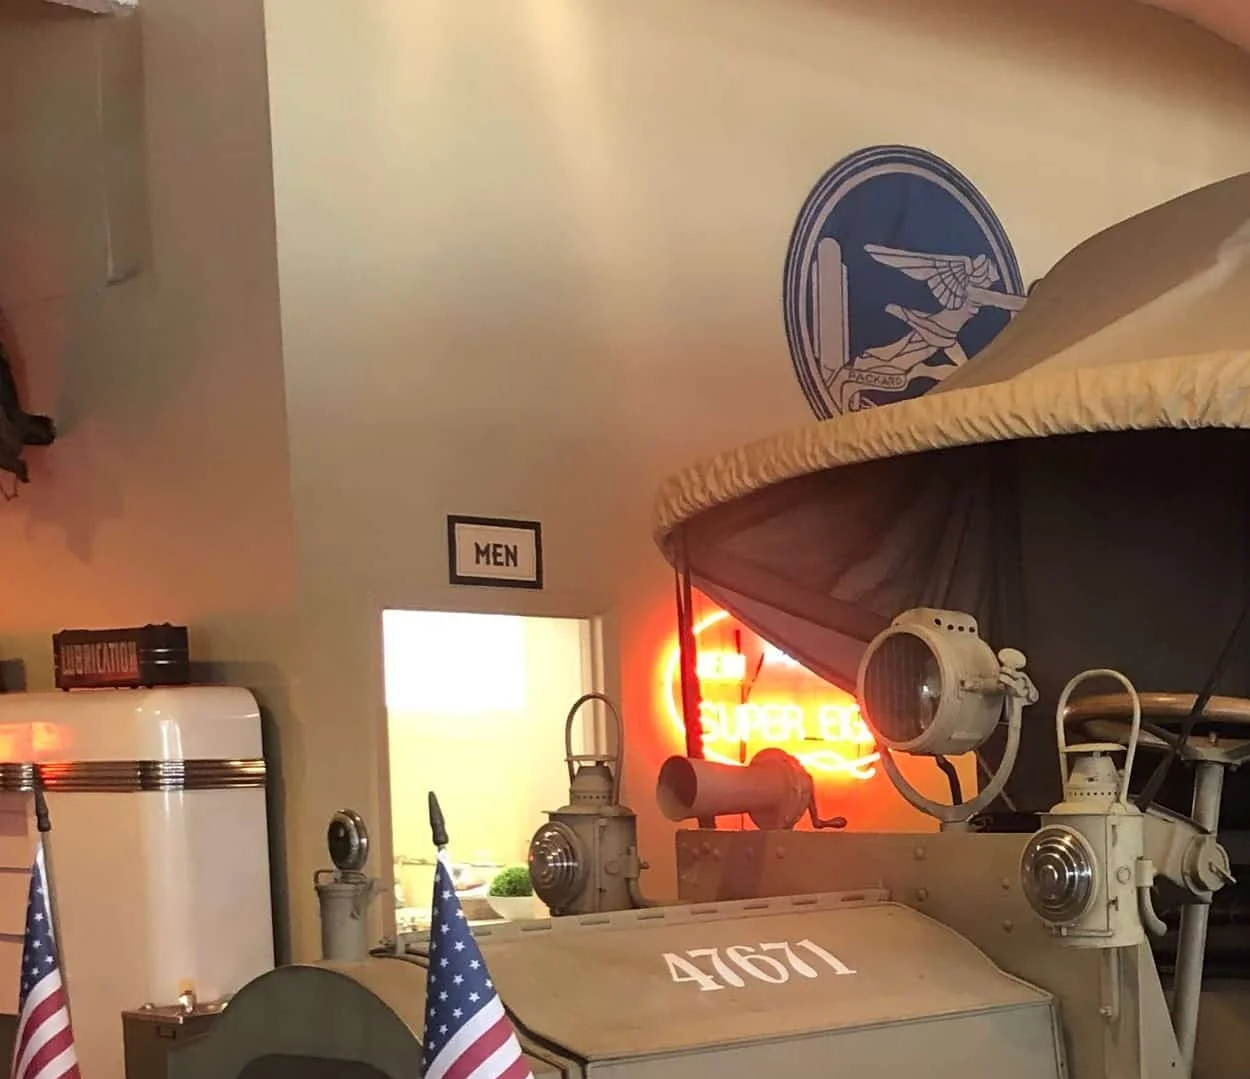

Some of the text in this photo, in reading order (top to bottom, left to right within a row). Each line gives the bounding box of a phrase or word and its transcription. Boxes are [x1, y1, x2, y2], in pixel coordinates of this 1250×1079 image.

[848, 370, 904, 386] PACKARD
[474, 541, 518, 568] MEN
[699, 701, 805, 743] SUPER
[662, 938, 857, 992] 47671
